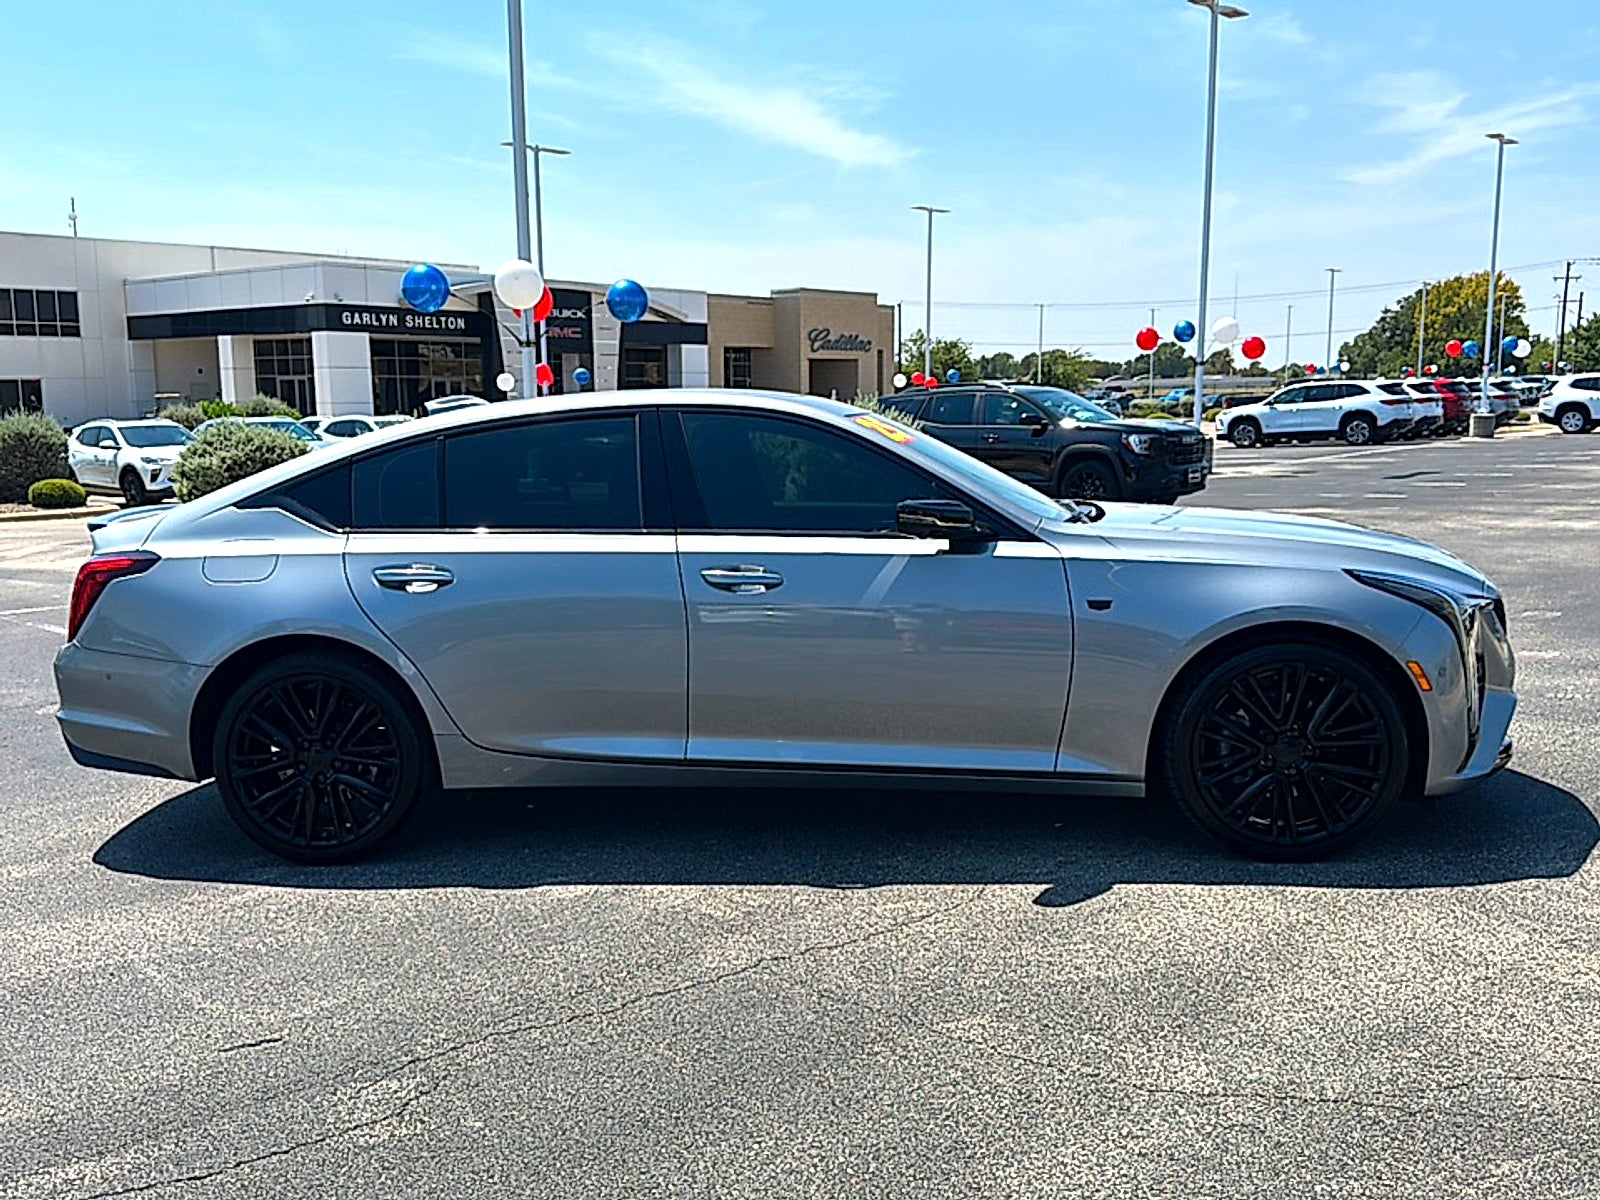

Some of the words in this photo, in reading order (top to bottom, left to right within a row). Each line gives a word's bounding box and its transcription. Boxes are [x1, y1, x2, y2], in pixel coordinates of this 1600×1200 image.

[341, 311, 398, 327] GARLYN
[404, 314, 466, 330] SHELTON
[808, 328, 873, 353] Cadillac
